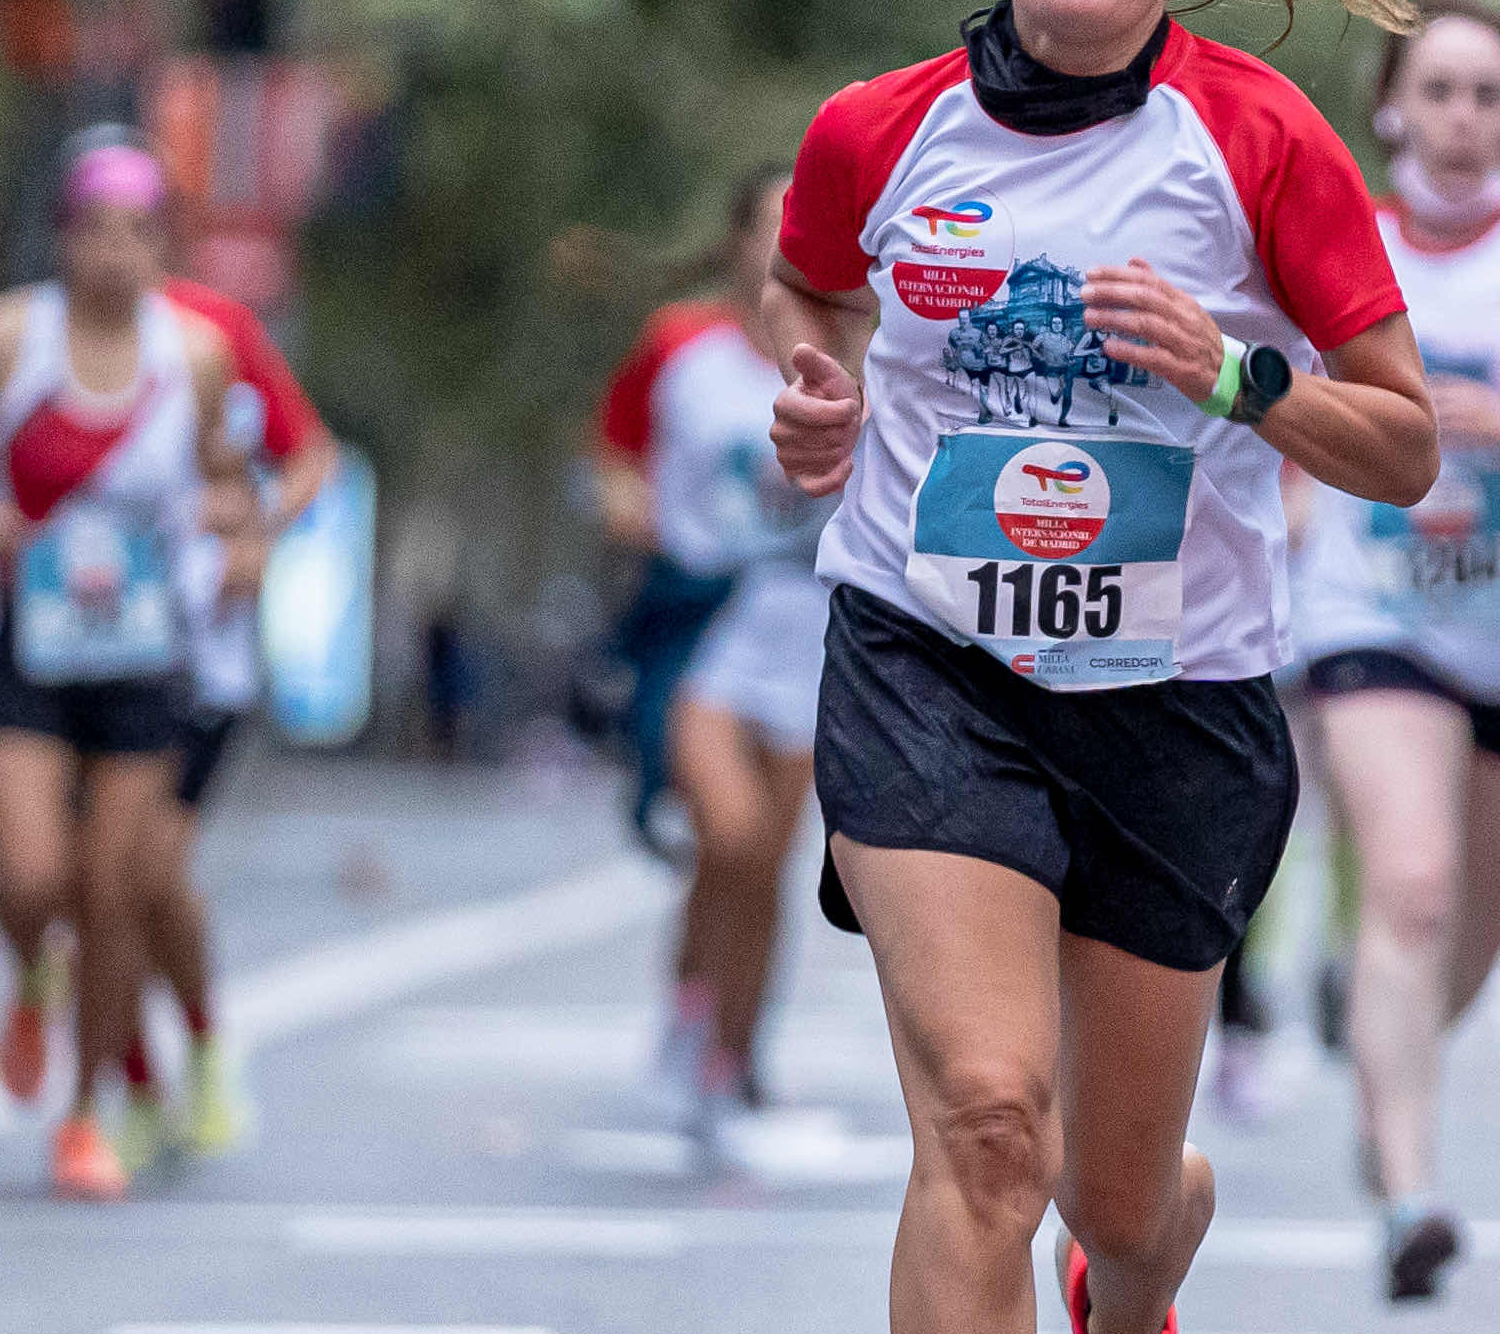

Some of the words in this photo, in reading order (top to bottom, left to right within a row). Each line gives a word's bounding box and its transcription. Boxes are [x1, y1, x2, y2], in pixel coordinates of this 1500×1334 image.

[923, 269, 959, 282] MILLA
[908, 294, 920, 306] DE
[923, 295, 972, 308] MADRID
[1021, 497, 1089, 510] TotalEnergies
[1036, 518, 1068, 529] MILLA
[1011, 527, 1092, 541] INTERNACIONAL
[1022, 538, 1037, 548] DE
[1040, 539, 1080, 549] MADRID
[967, 562, 1123, 639] 1165
